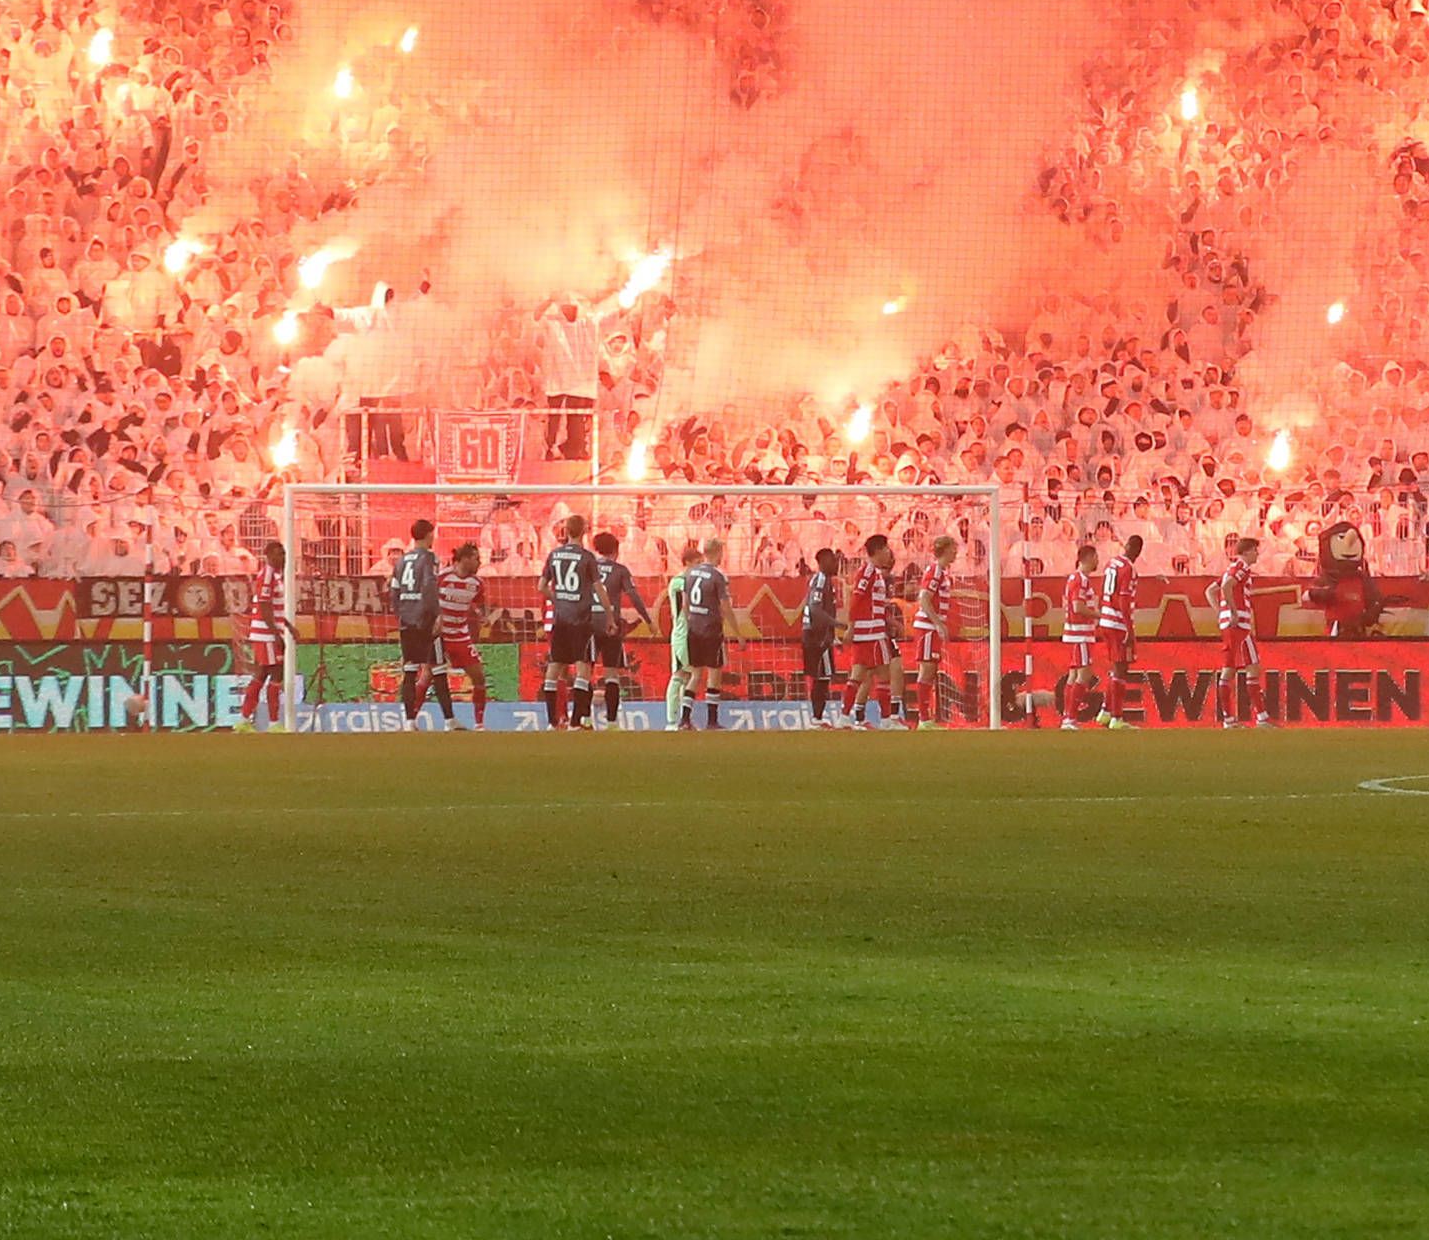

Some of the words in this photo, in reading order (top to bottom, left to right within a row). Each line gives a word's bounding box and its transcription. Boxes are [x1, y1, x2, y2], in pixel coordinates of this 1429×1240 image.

[401, 561, 416, 591] 4
[552, 560, 580, 591] 16
[690, 577, 702, 605] 6
